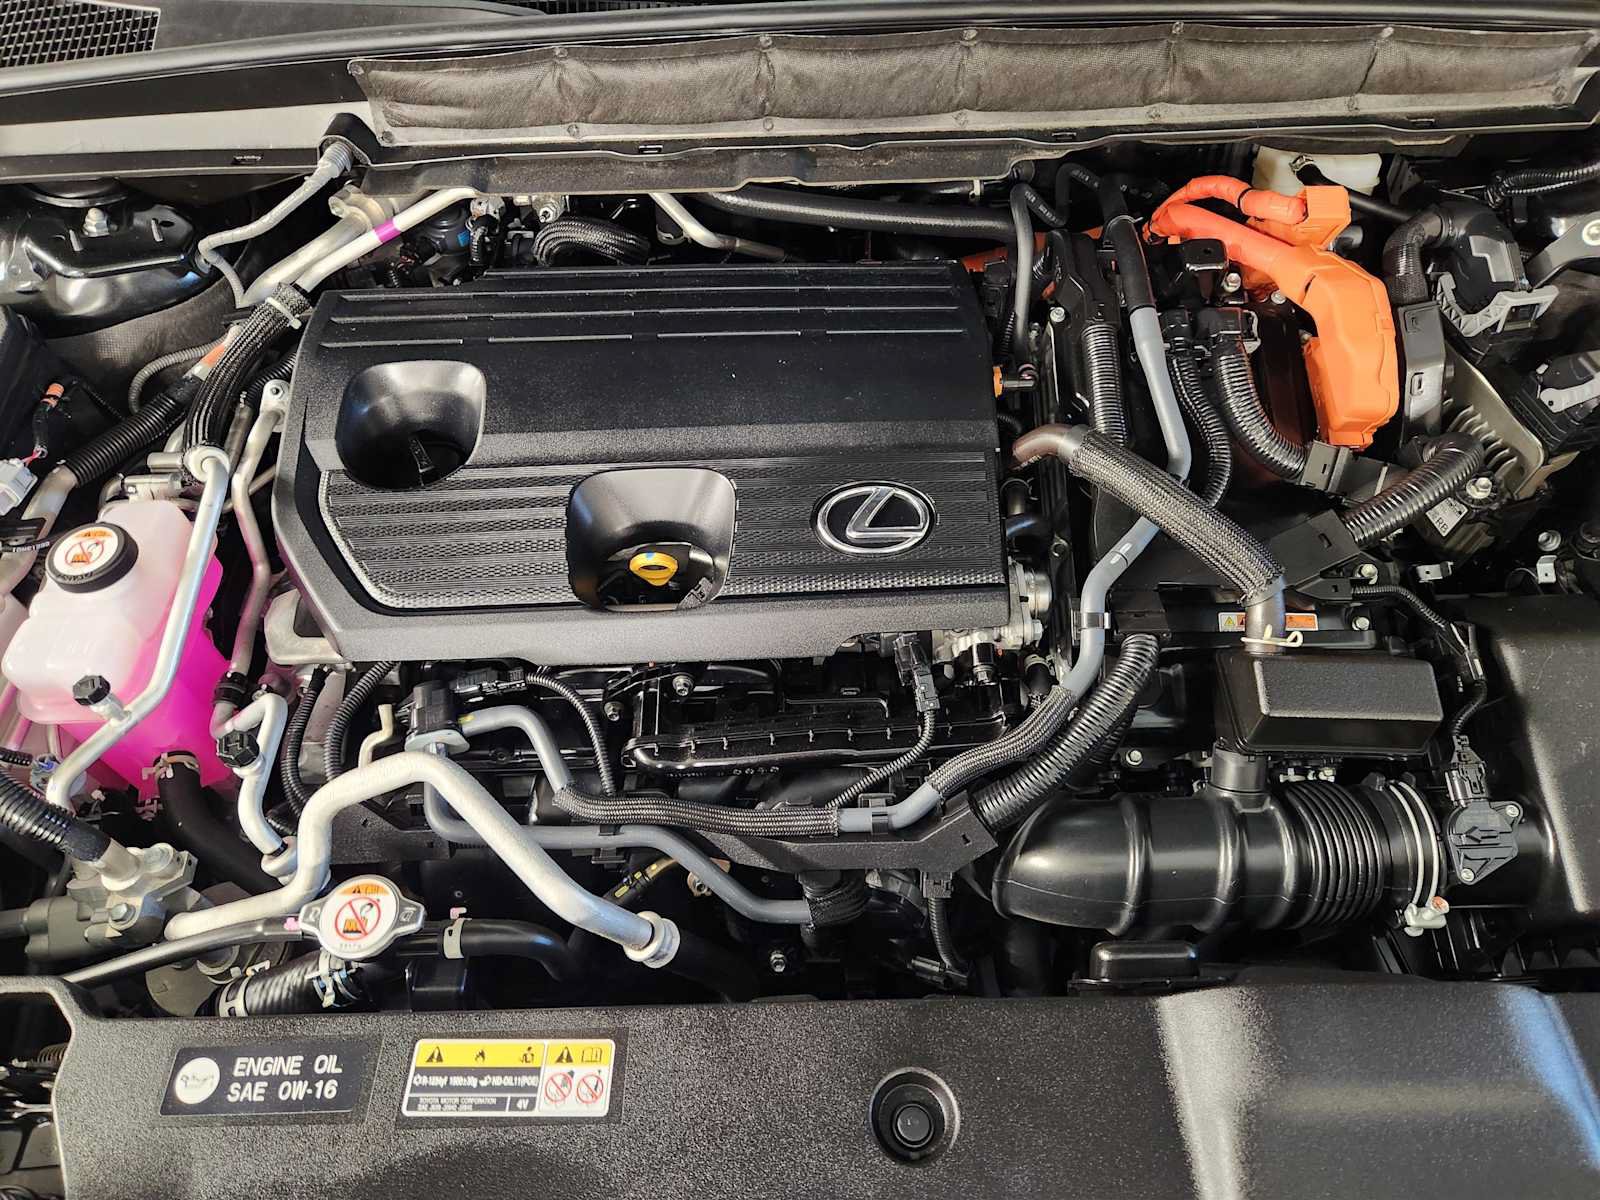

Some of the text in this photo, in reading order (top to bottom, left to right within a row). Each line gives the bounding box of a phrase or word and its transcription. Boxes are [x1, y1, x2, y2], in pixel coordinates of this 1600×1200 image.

[233, 1054, 343, 1077] ENGINE OIL
[227, 1081, 268, 1103] SAE
